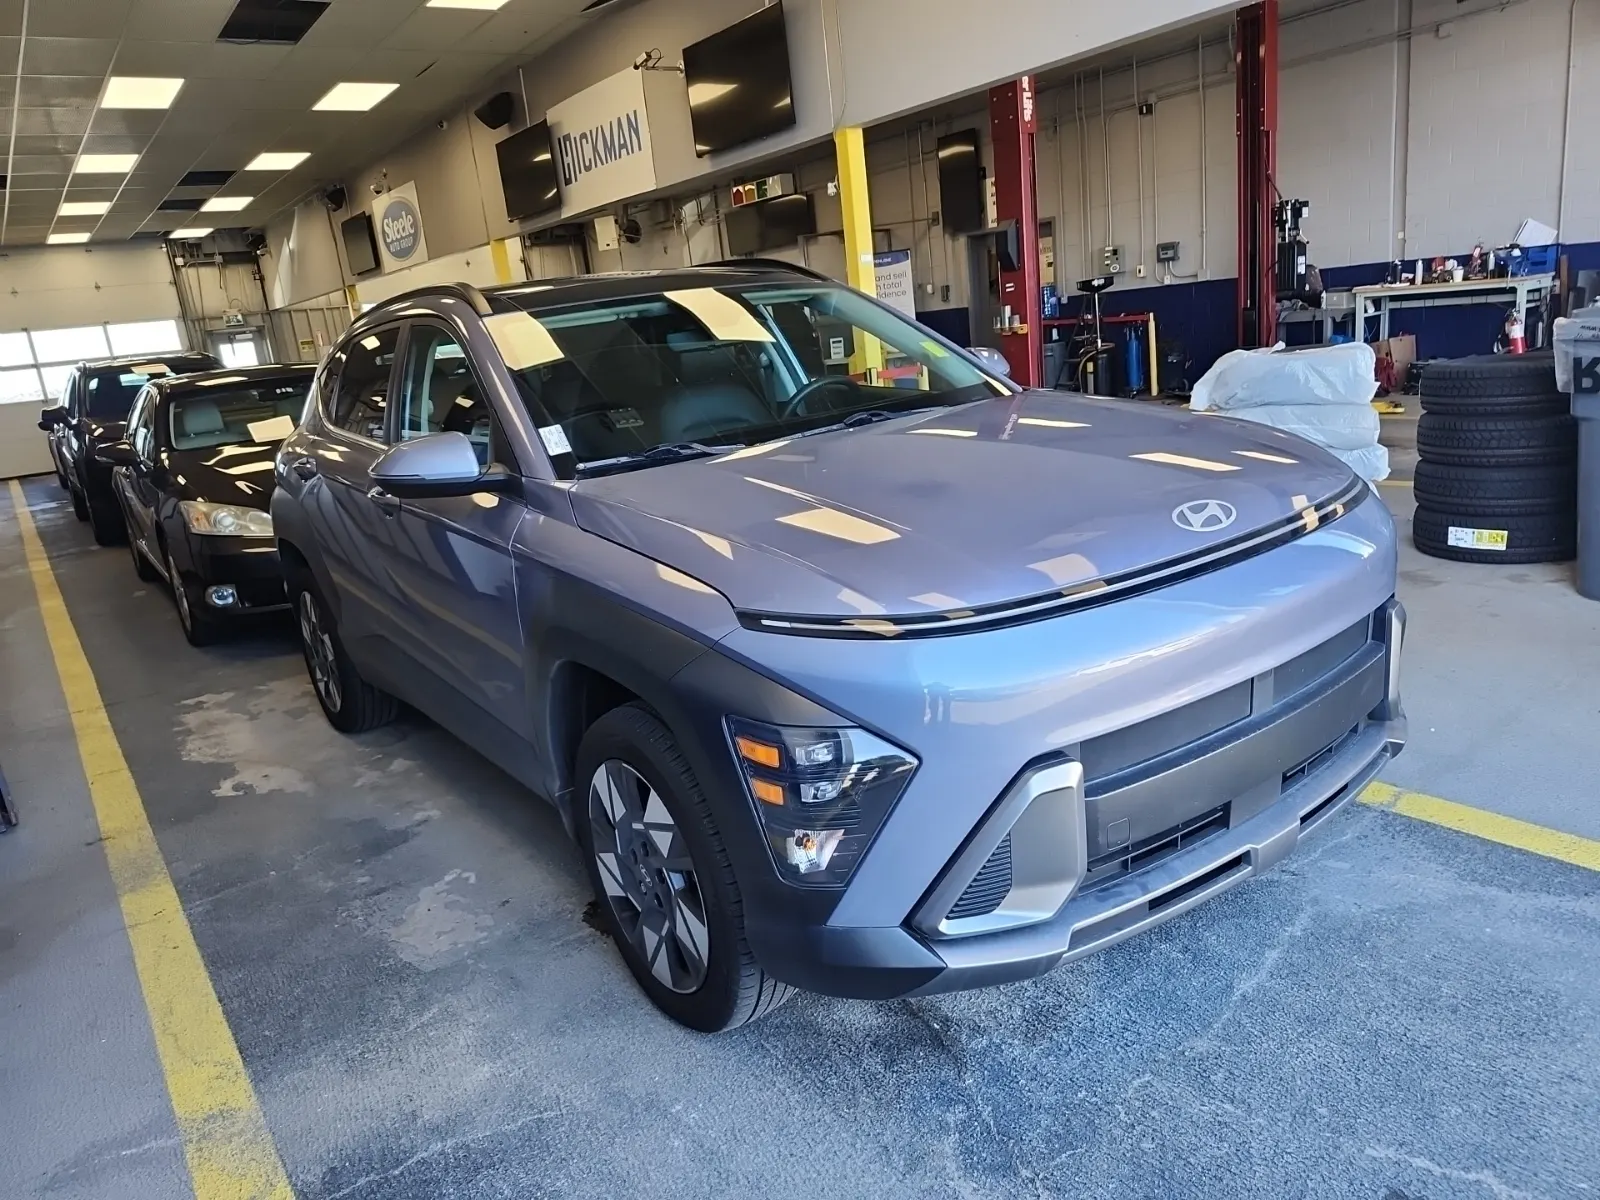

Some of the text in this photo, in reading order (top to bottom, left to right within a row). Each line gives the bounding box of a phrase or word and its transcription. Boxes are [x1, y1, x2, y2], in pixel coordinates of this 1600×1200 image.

[384, 211, 415, 243] Steele
[875, 270, 907, 281] and sell
[883, 281, 902, 290] total
